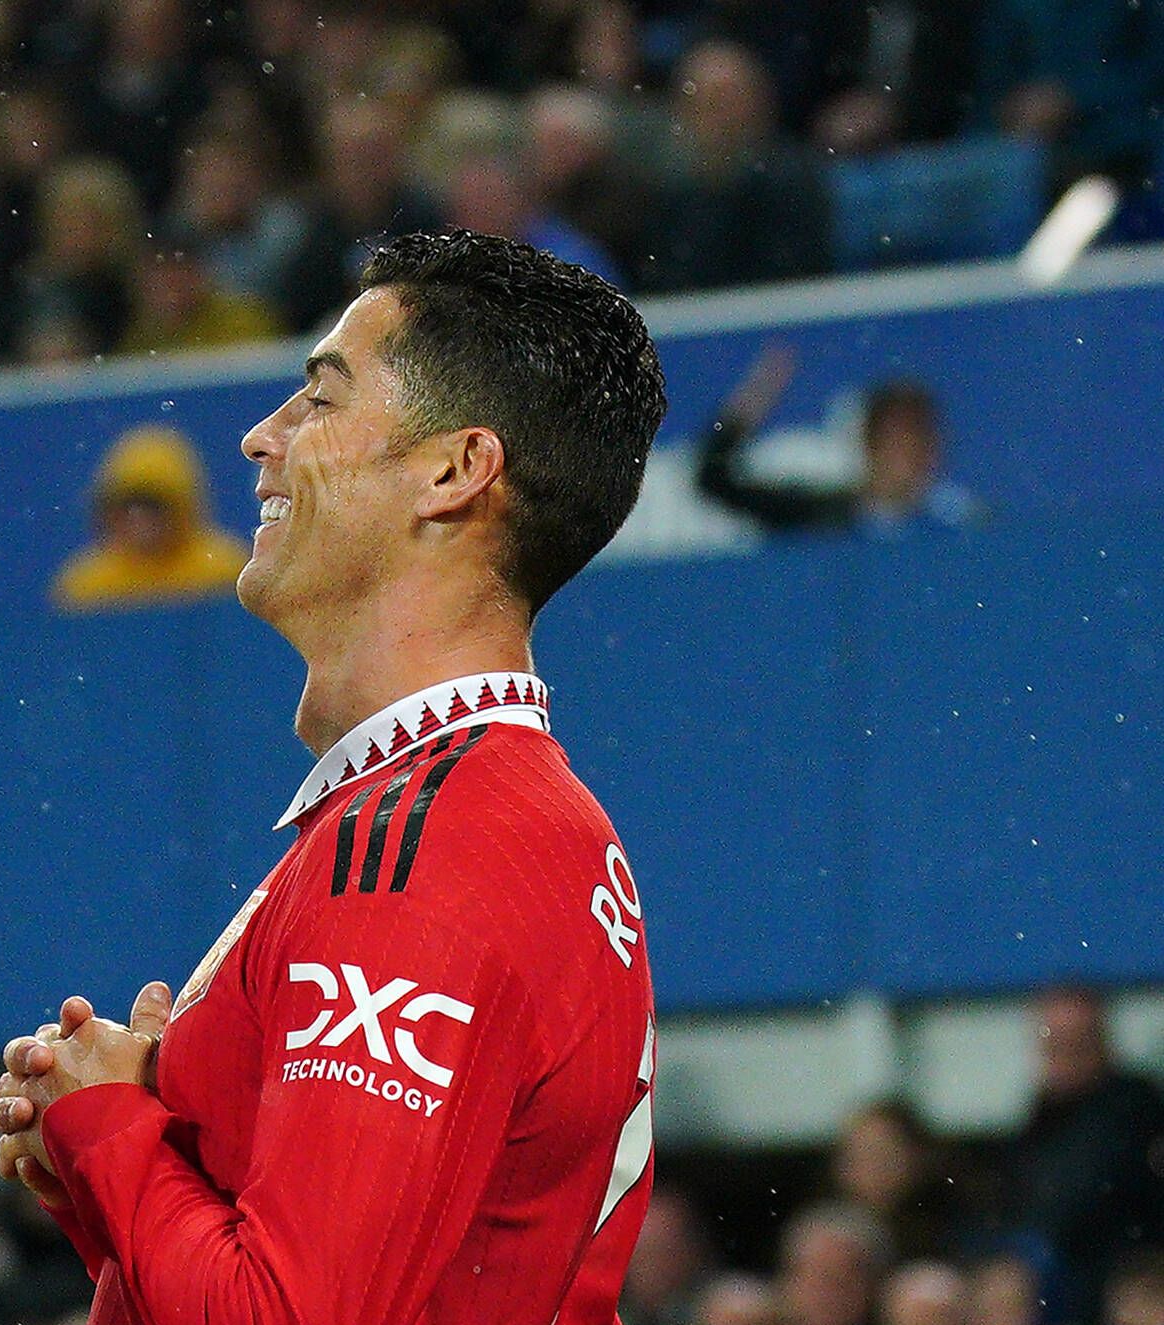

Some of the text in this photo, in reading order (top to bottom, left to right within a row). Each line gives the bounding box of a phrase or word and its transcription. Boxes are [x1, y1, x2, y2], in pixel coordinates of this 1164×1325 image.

[590, 841, 643, 970] RO
[282, 1057, 444, 1118] TECHNOLOGY
[285, 962, 476, 1089] DXC
